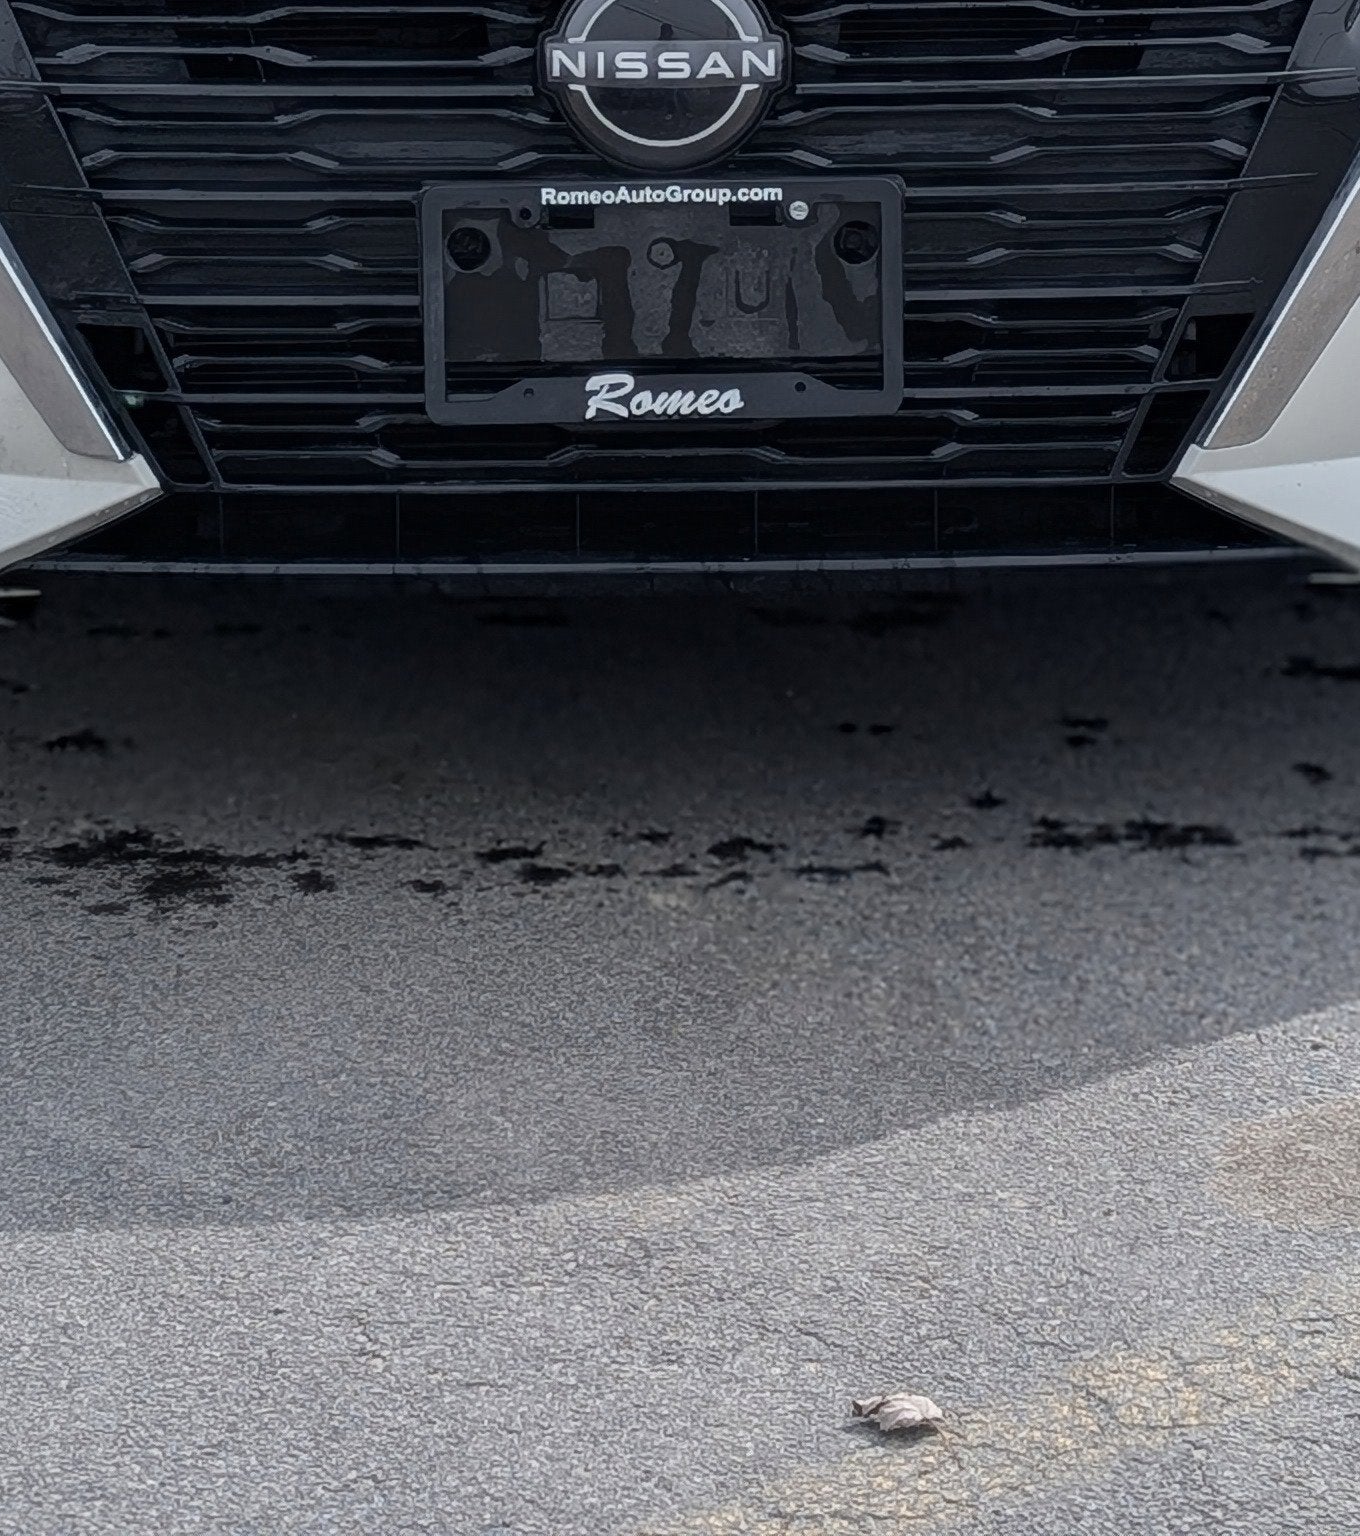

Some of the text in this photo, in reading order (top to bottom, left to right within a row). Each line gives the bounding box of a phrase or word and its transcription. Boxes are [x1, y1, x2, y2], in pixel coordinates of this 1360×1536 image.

[551, 48, 777, 80] NISSAN
[540, 184, 783, 206] RomeoAutoGroup.com
[584, 373, 745, 420] Romeo
